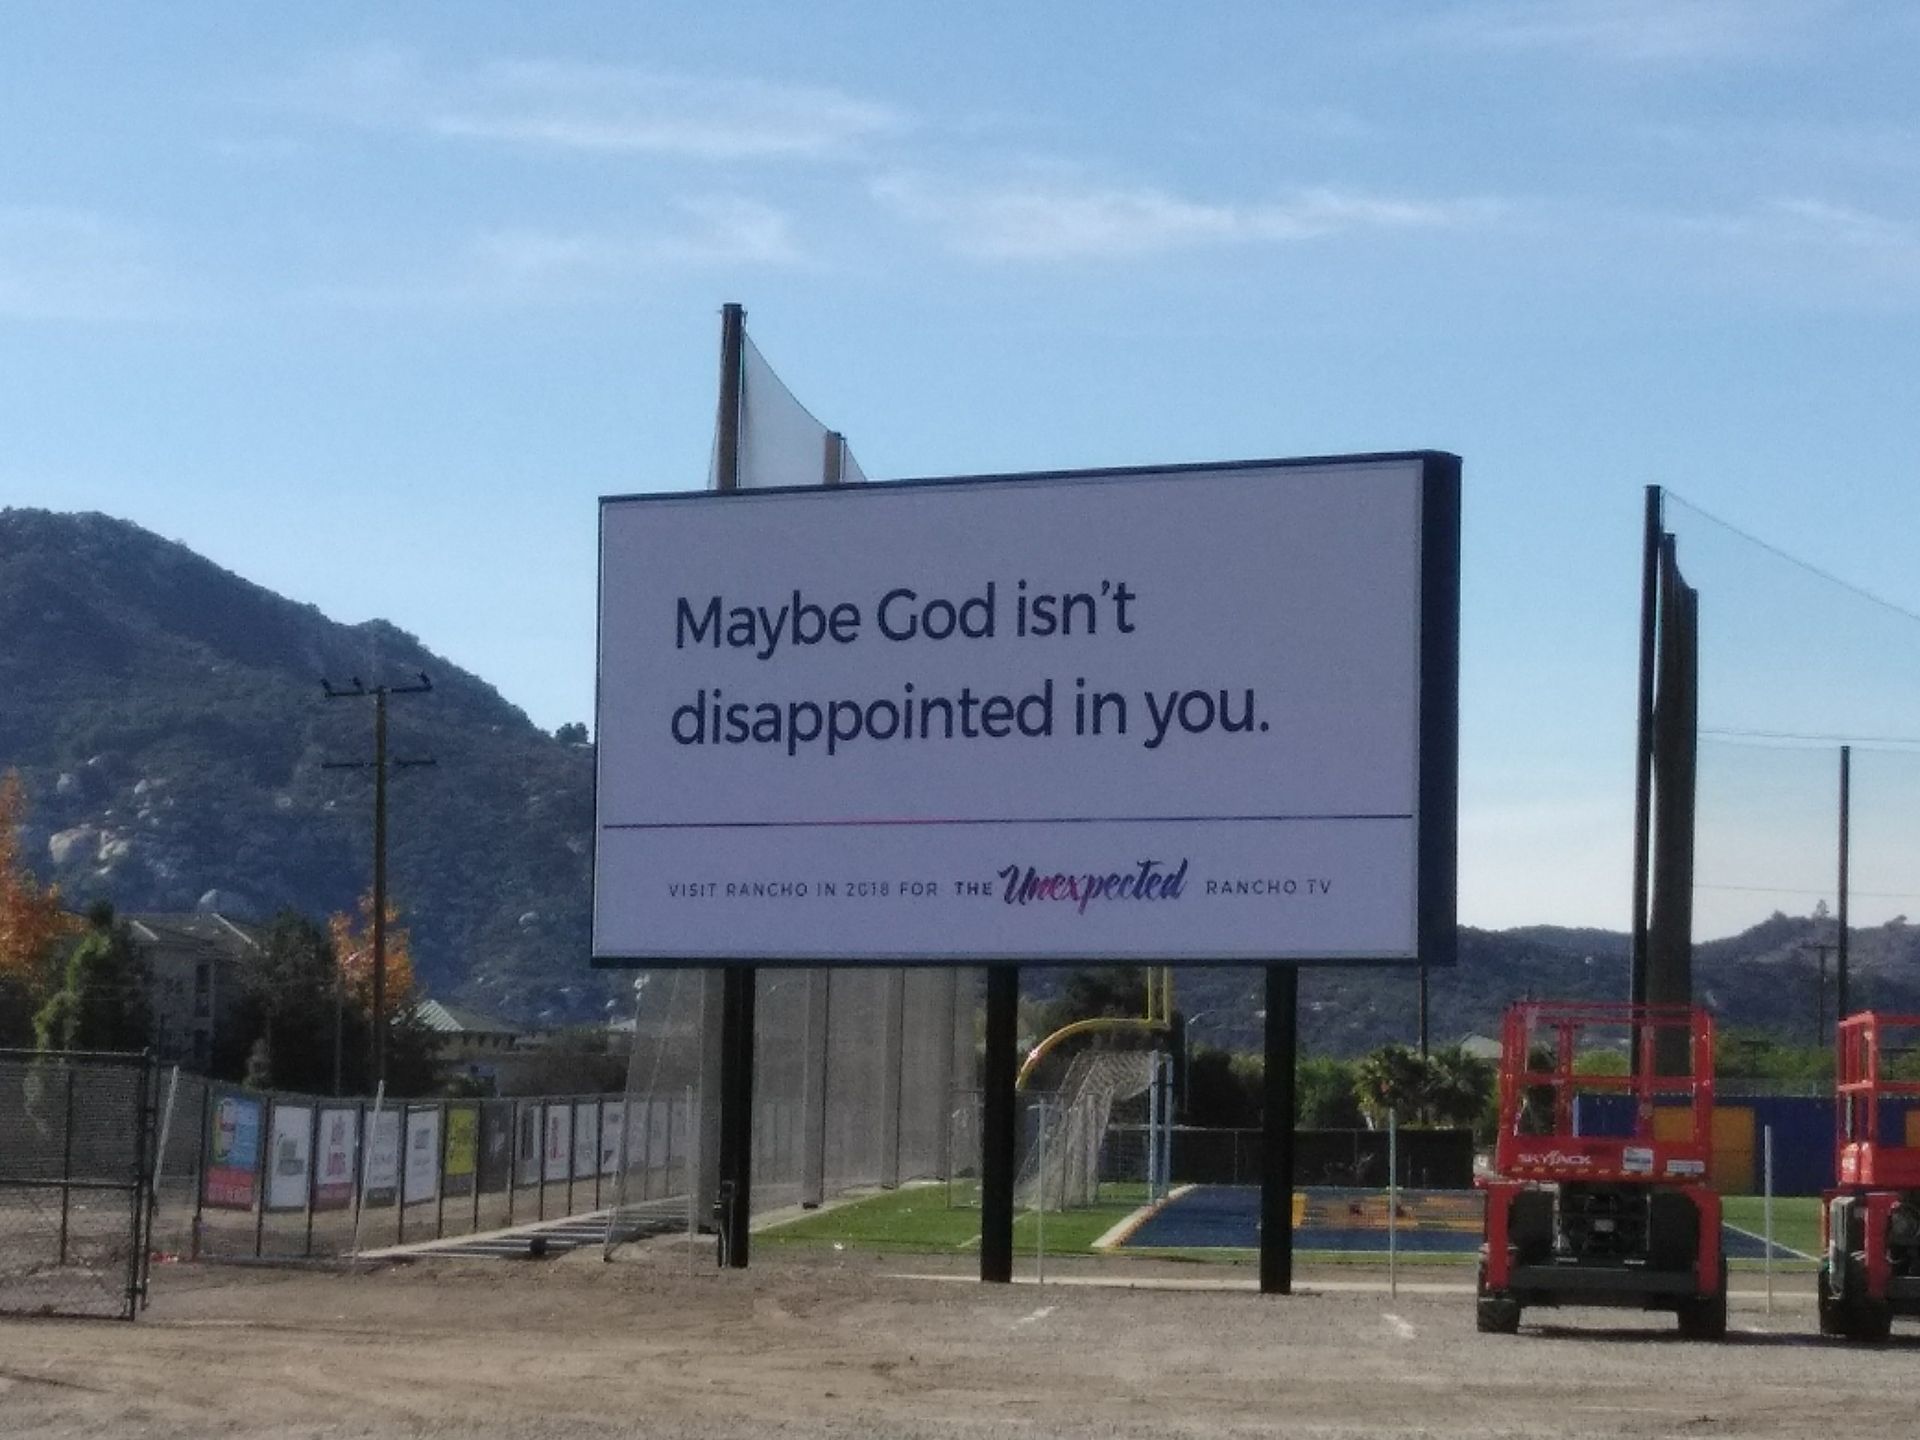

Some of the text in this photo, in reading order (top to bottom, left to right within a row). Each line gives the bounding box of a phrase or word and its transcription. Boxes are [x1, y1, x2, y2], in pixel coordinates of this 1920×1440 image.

[675, 579, 1137, 660] Maybe God isn't
[671, 677, 1270, 756] disappointed in you.
[668, 857, 1332, 916] VISIT RANCHO IN 2018 FOR THE Unexpected RANCHO TV
